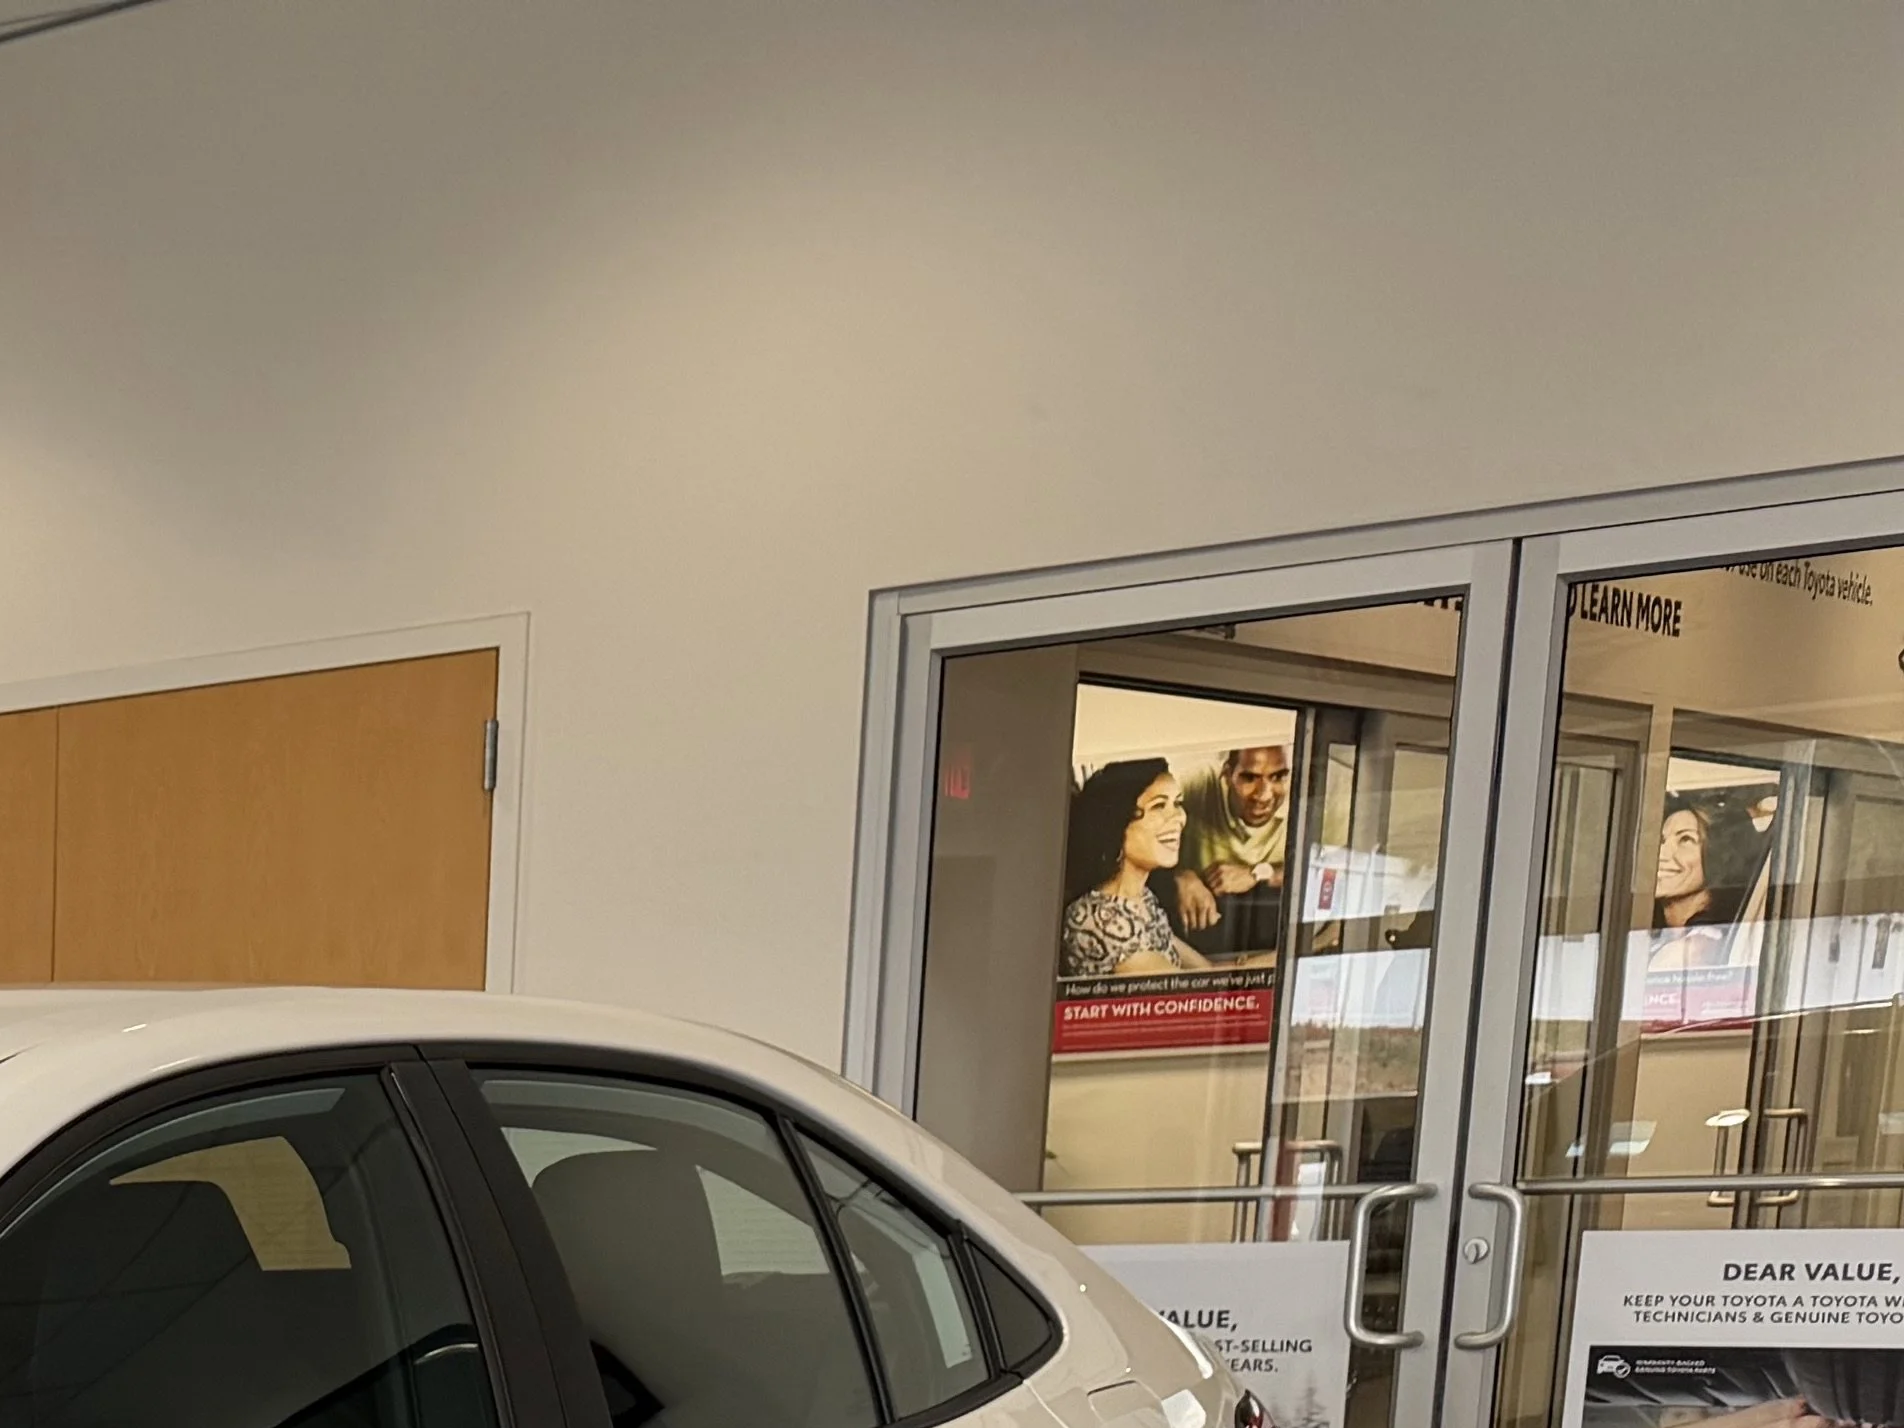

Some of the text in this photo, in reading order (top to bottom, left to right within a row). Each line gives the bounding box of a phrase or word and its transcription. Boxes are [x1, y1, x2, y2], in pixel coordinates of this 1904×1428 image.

[1776, 559, 1801, 589] each
[1803, 560, 1836, 600] Toyota
[1837, 571, 1873, 606] vehicle.
[1580, 583, 1633, 628] LEARN
[1635, 592, 1682, 637] MORE
[1128, 976, 1169, 995] protect
[1171, 974, 1189, 989] the
[1192, 979, 1211, 989] car
[1244, 972, 1265, 988] just
[1064, 995, 1260, 1021] START WITH CONFIDENCE.
[1722, 1263, 1901, 1285] DEAR VALUE,
[1623, 1295, 1664, 1307] KEEP
[1669, 1295, 1715, 1307] YOUR
[1722, 1295, 1787, 1308] TOYOTA
[1792, 1295, 1804, 1307] A
[1811, 1295, 1877, 1308] TOYOTA
[1634, 1310, 1747, 1324] TECHNICIANS
[1753, 1311, 1764, 1324] &
[1770, 1311, 1850, 1324] GENUINE
